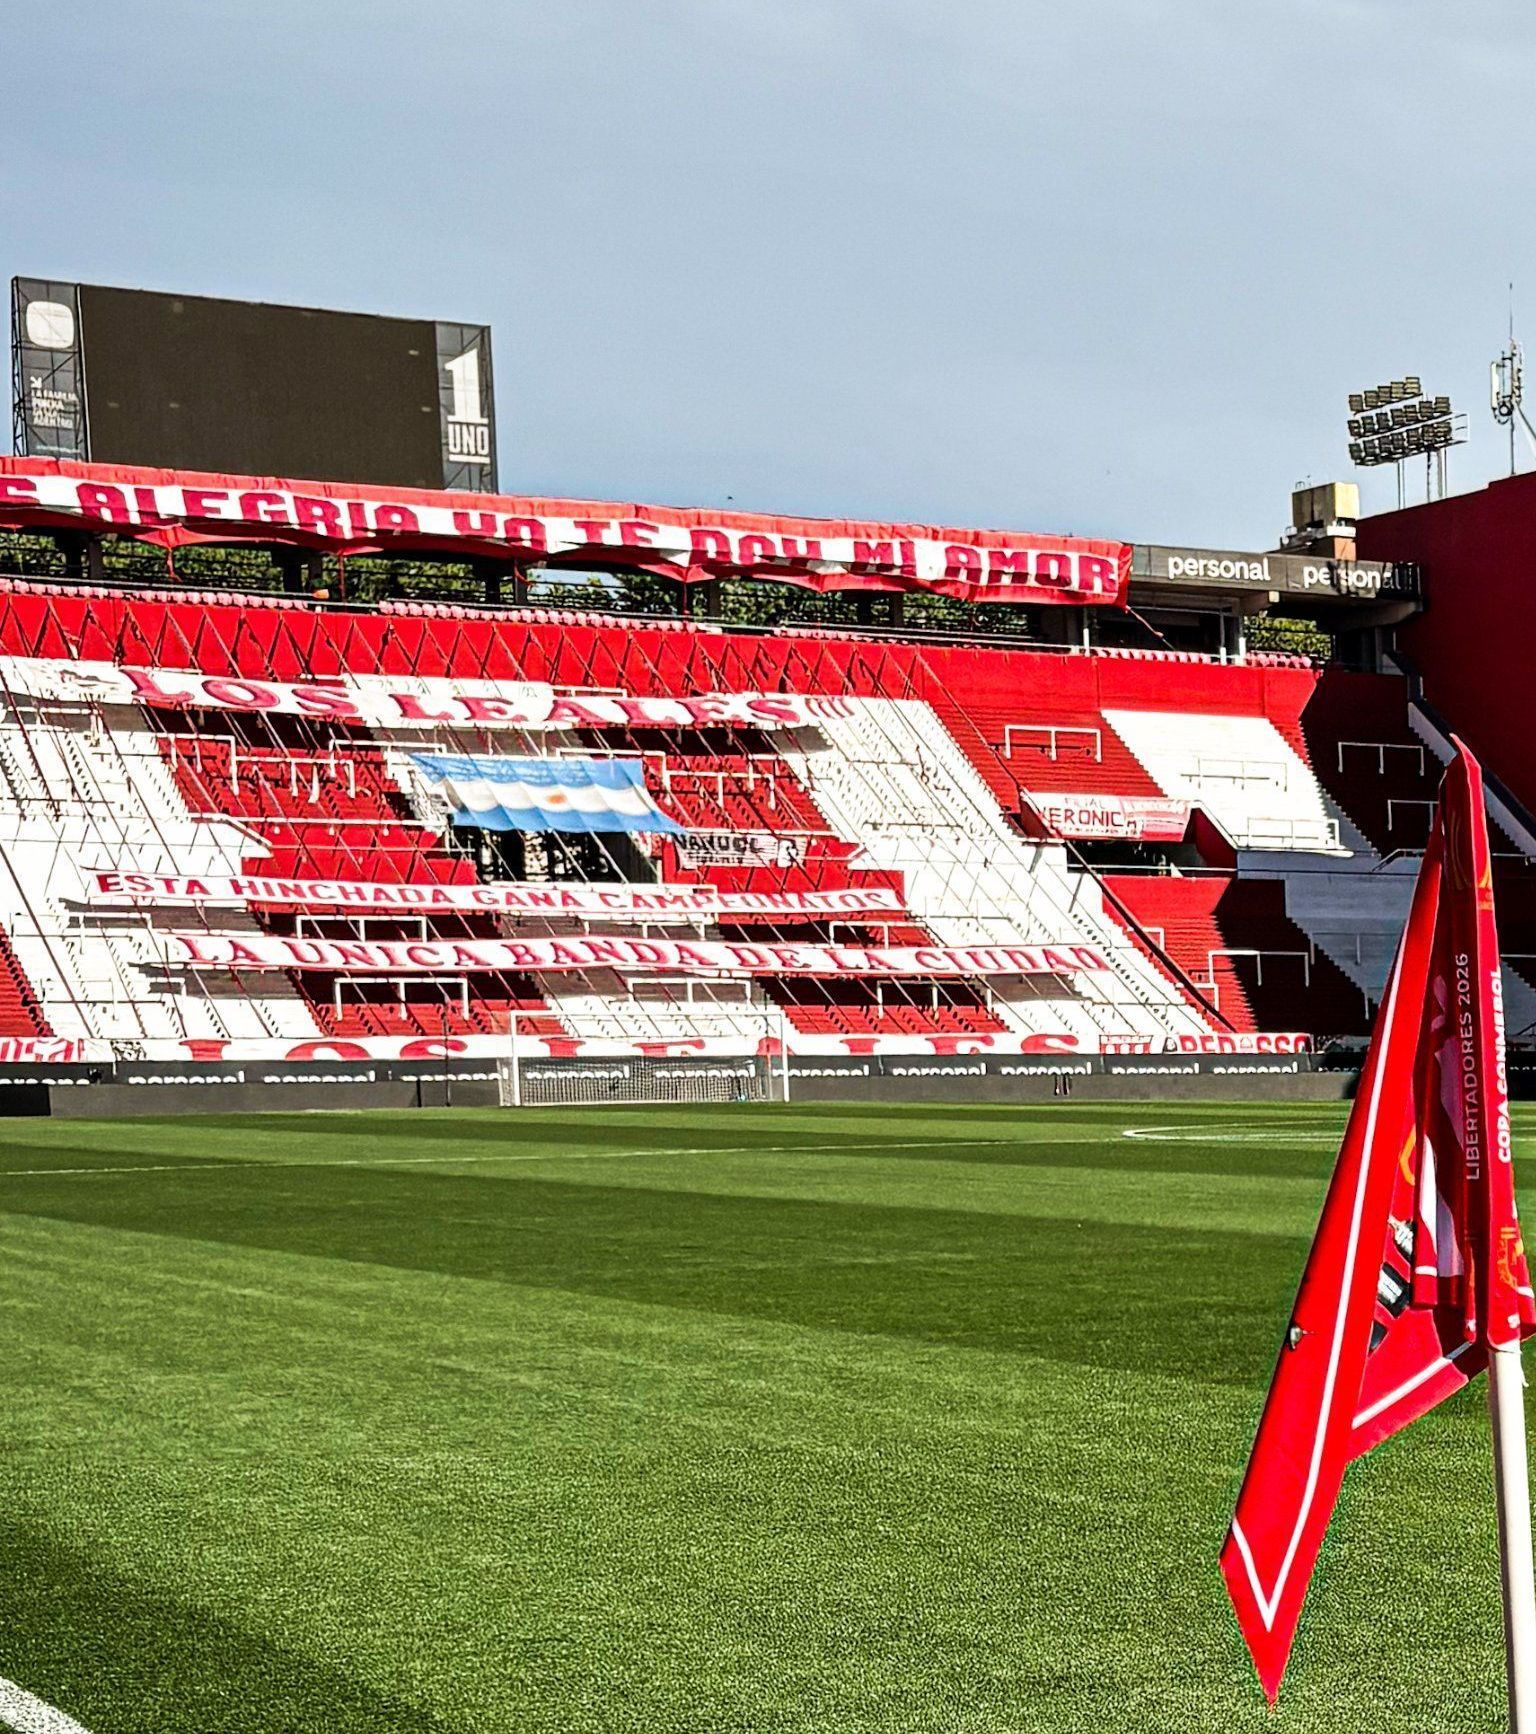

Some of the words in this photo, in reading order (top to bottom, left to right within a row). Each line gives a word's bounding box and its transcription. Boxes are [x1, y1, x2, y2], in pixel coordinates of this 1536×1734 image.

[447, 421, 489, 456] UNO
[77, 482, 421, 538] ALEGRIA
[573, 520, 659, 547] TE
[853, 540, 917, 577] MI
[944, 545, 1118, 595] AMOR
[1168, 556, 1271, 581] personal
[119, 668, 361, 716] LOS
[389, 694, 801, 725] LEALES
[1043, 806, 1137, 829] ERONICA
[97, 873, 210, 897] ESTA
[234, 879, 456, 905] HINCHADA
[472, 890, 585, 909] GANA
[176, 936, 267, 963] LA
[287, 940, 492, 967] UNICA
[501, 940, 719, 967] BANDA
[726, 946, 811, 969] DE
[822, 950, 898, 970] LA
[914, 948, 1111, 972] CIUDAD
[1455, 952, 1471, 1005] 2026
[1459, 1011, 1480, 1181] LIBERTADORES
[1497, 1101, 1511, 1163] COPA
